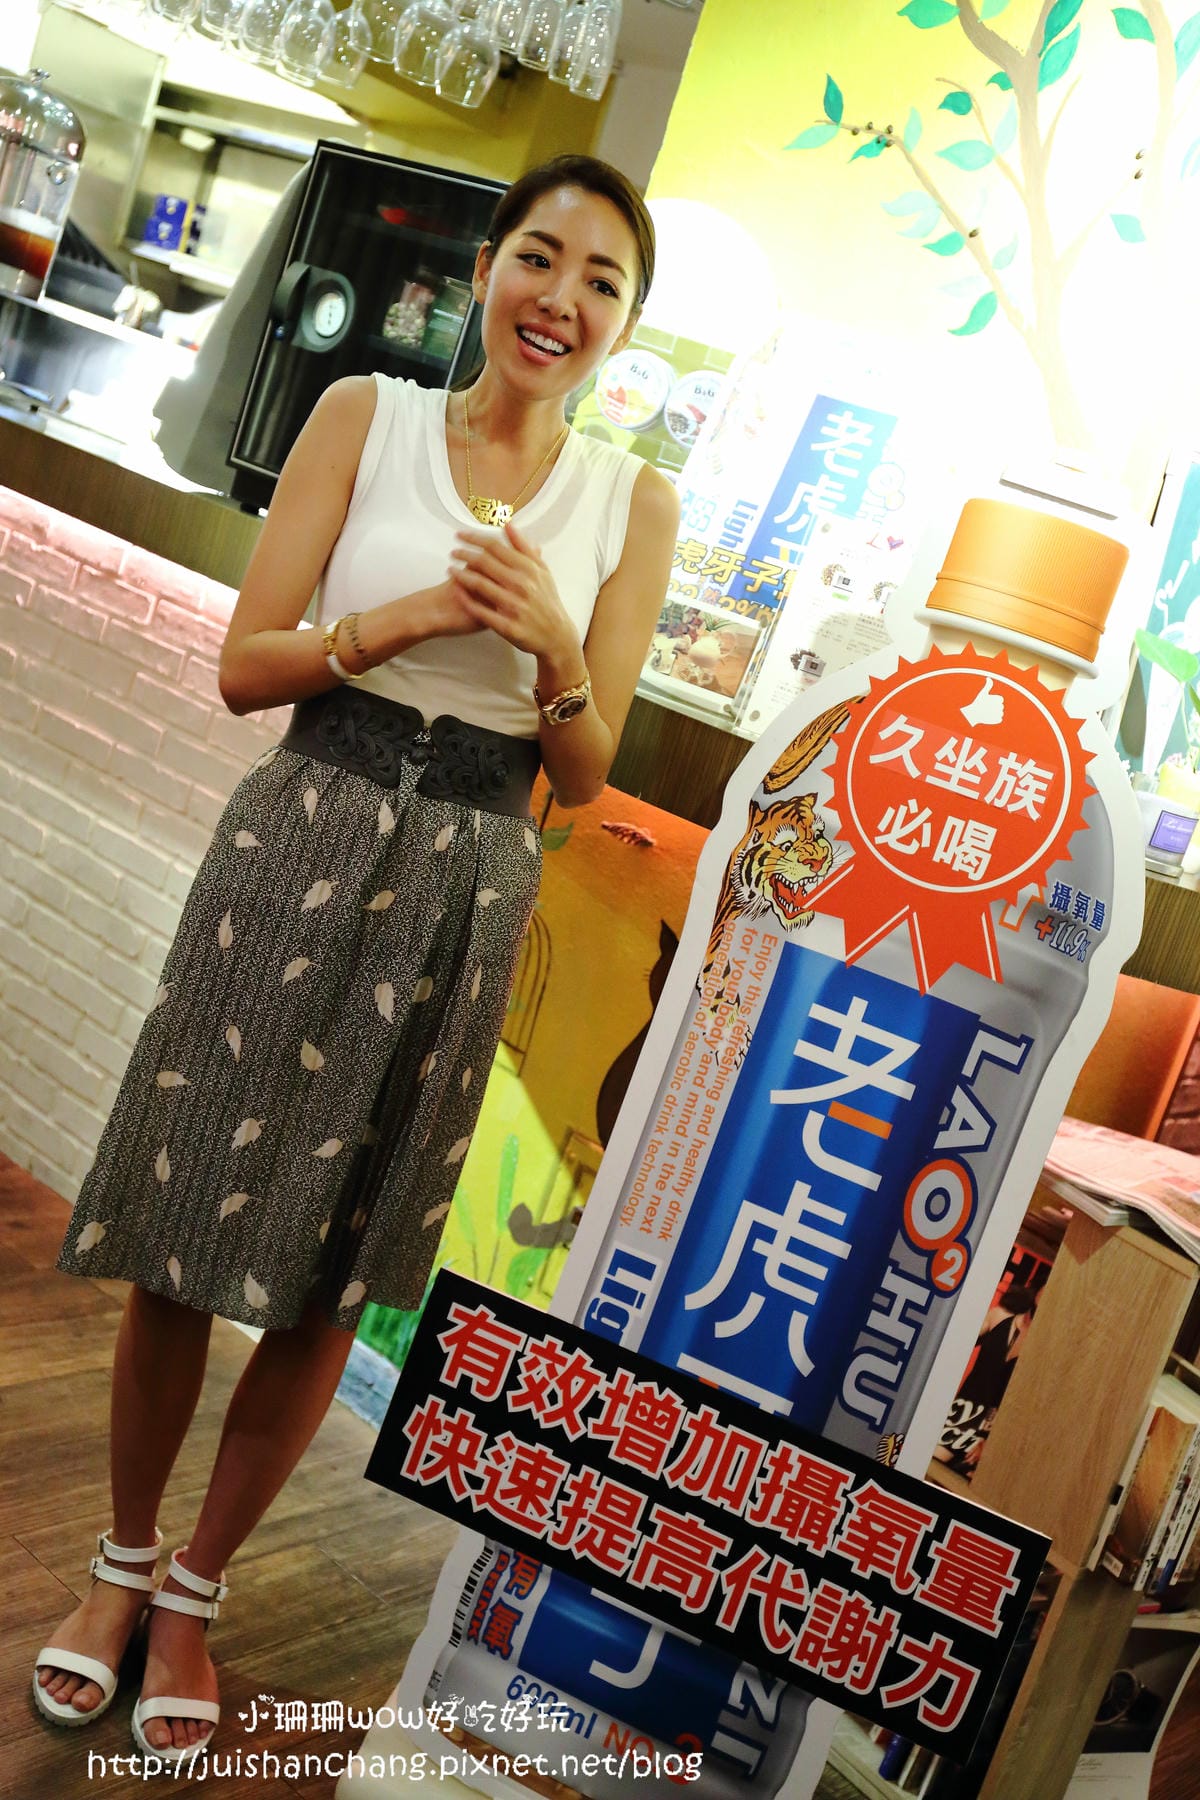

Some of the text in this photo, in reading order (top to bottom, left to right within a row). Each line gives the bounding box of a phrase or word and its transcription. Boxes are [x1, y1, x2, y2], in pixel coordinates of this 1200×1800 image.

[869, 713, 1055, 822] 久坐族
[874, 798, 997, 881] 必喝
[1048, 880, 1106, 932] 攝氧量
[618, 917, 737, 1228] generation of aerobic drink technology.
[639, 927, 759, 1234] for your body and mind in the next
[658, 933, 779, 1241] Enjoy this refreshing and healthy drink
[402, 1395, 982, 1733] 快速提高代謝力
[438, 1303, 1022, 1636] 有效增加攝氧量
[467, 1550, 510, 1646] DRINK
